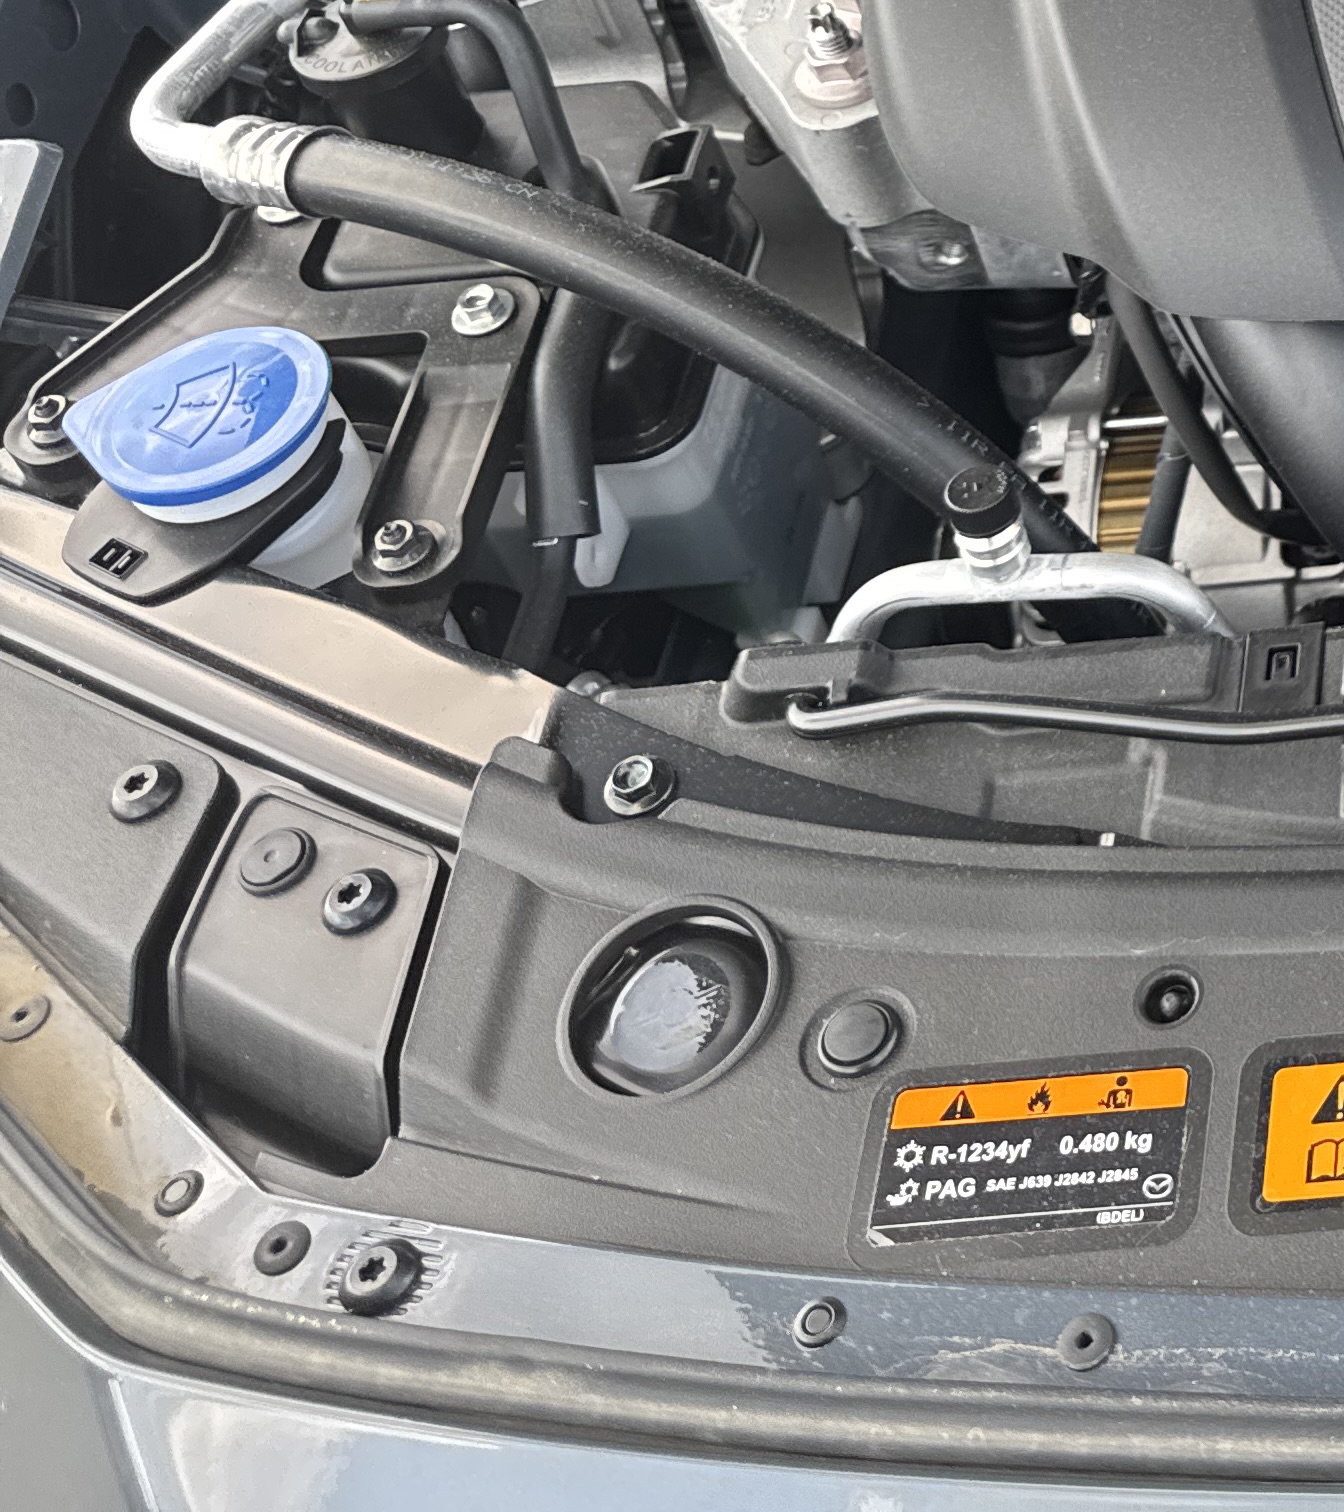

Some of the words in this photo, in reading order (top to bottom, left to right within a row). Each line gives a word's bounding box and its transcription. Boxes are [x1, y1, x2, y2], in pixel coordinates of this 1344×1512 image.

[930, 1138, 1032, 1166] R-1234yf
[1059, 1131, 1119, 1156] 0.480
[1124, 1131, 1153, 1154] kg
[924, 1178, 977, 1201] PAG
[985, 1177, 1018, 1193] SAE
[1018, 1175, 1052, 1191] J639
[1053, 1172, 1096, 1188] J2842
[1097, 1168, 1140, 1185] J2845
